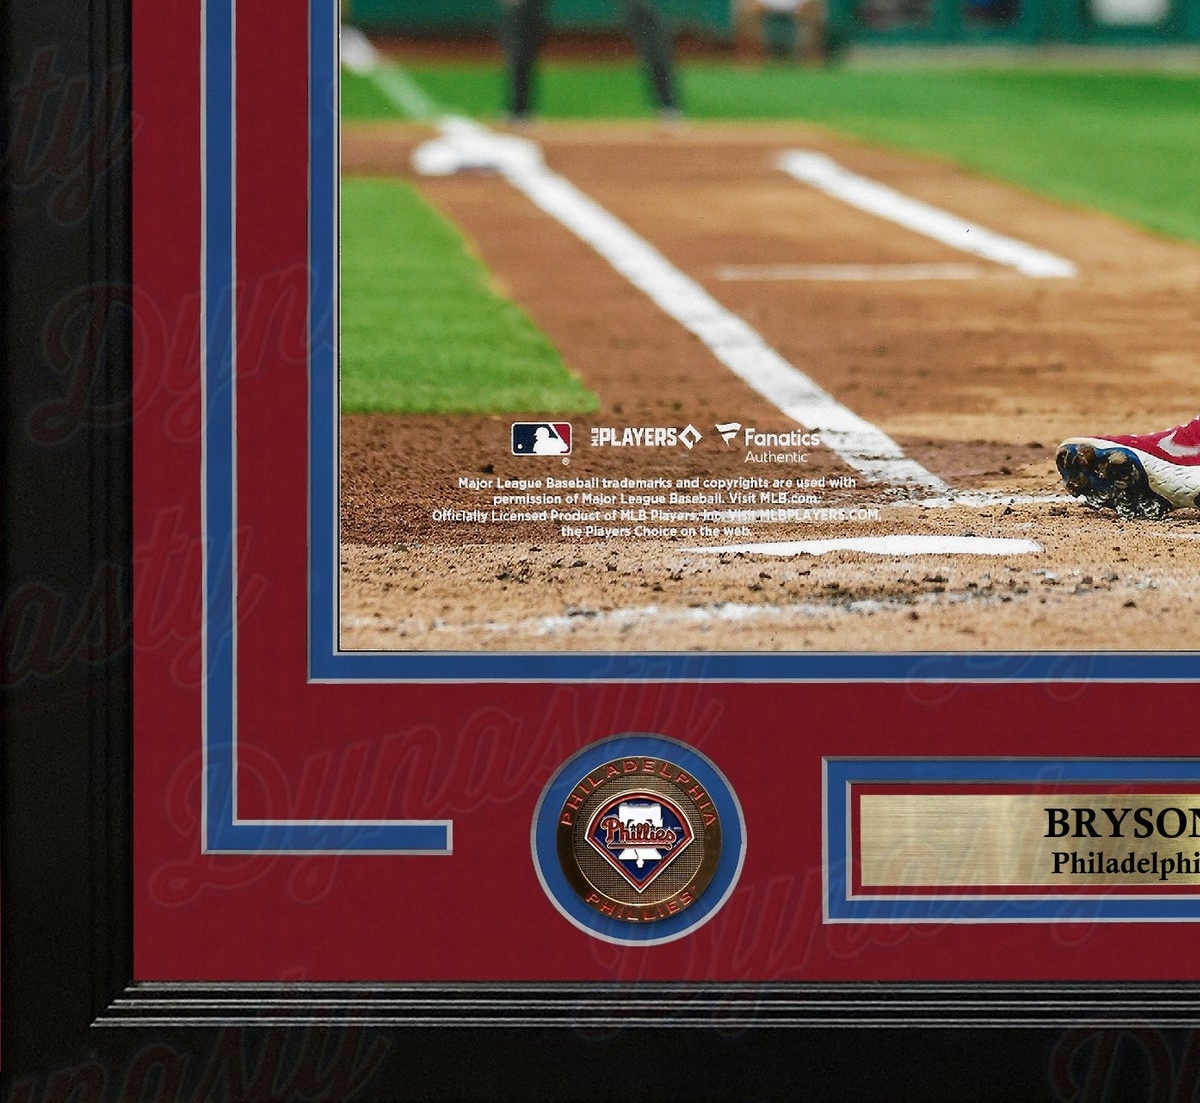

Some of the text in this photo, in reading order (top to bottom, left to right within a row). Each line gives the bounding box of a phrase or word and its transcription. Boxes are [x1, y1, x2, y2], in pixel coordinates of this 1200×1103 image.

[600, 428, 677, 446] PLAYERS
[744, 429, 820, 446] Fanatics
[744, 450, 809, 463] Authentic
[458, 477, 856, 490] Major League Baseball trademarks and copyrights are used with
[493, 493, 561, 506] permission
[566, 493, 578, 504] of
[582, 493, 616, 506] Major
[620, 493, 666, 506] League
[670, 493, 725, 504] Baseball.
[730, 493, 756, 504] Visit
[432, 509, 488, 523] Officially
[492, 509, 547, 522] Licensed
[551, 509, 600, 522] Product
[604, 509, 617, 521] of
[620, 509, 646, 522] MLB
[561, 525, 583, 537] the
[586, 525, 631, 539] Players
[635, 525, 676, 537] Choice
[681, 525, 696, 537] on
[700, 525, 719, 537] the
[560, 759, 717, 826] PHILADELPHIA
[601, 815, 677, 844] Phillies
[586, 890, 694, 921] PHILLIES
